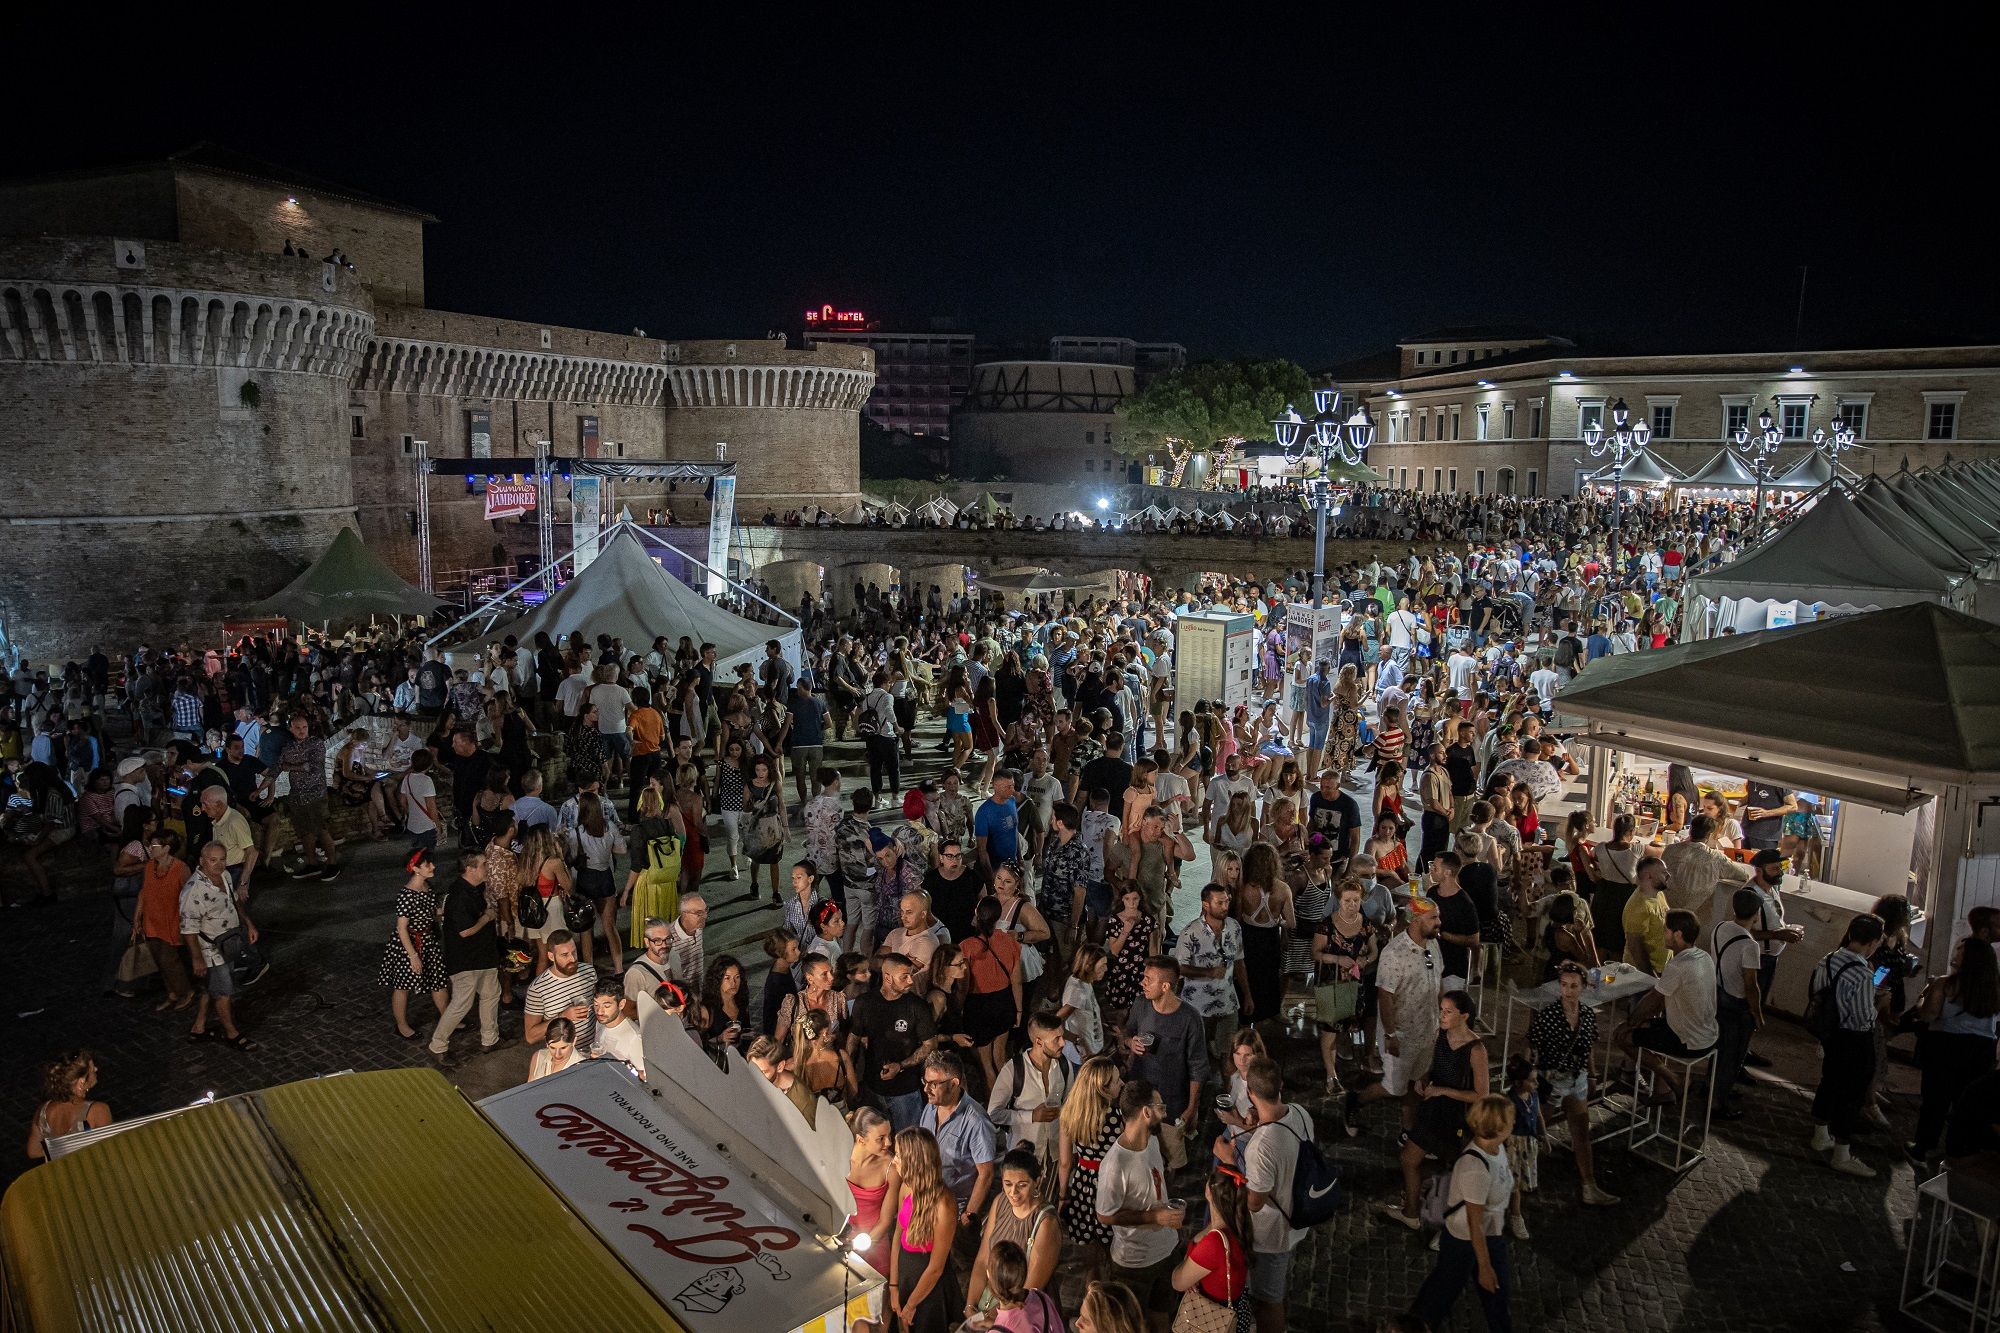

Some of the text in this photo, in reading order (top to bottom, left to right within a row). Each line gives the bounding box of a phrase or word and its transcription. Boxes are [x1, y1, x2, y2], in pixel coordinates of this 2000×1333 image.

[488, 476, 535, 493] Summer
[488, 492, 536, 509] JAMBOREE
[1287, 613, 1315, 626] JAMBOREE
[609, 1091, 654, 1129] ROCK'N'ROLL
[656, 1134, 678, 1152] VINO
[674, 1150, 700, 1170] PANE
[535, 1102, 801, 1265] Furgoncino
[608, 1197, 650, 1213] il
